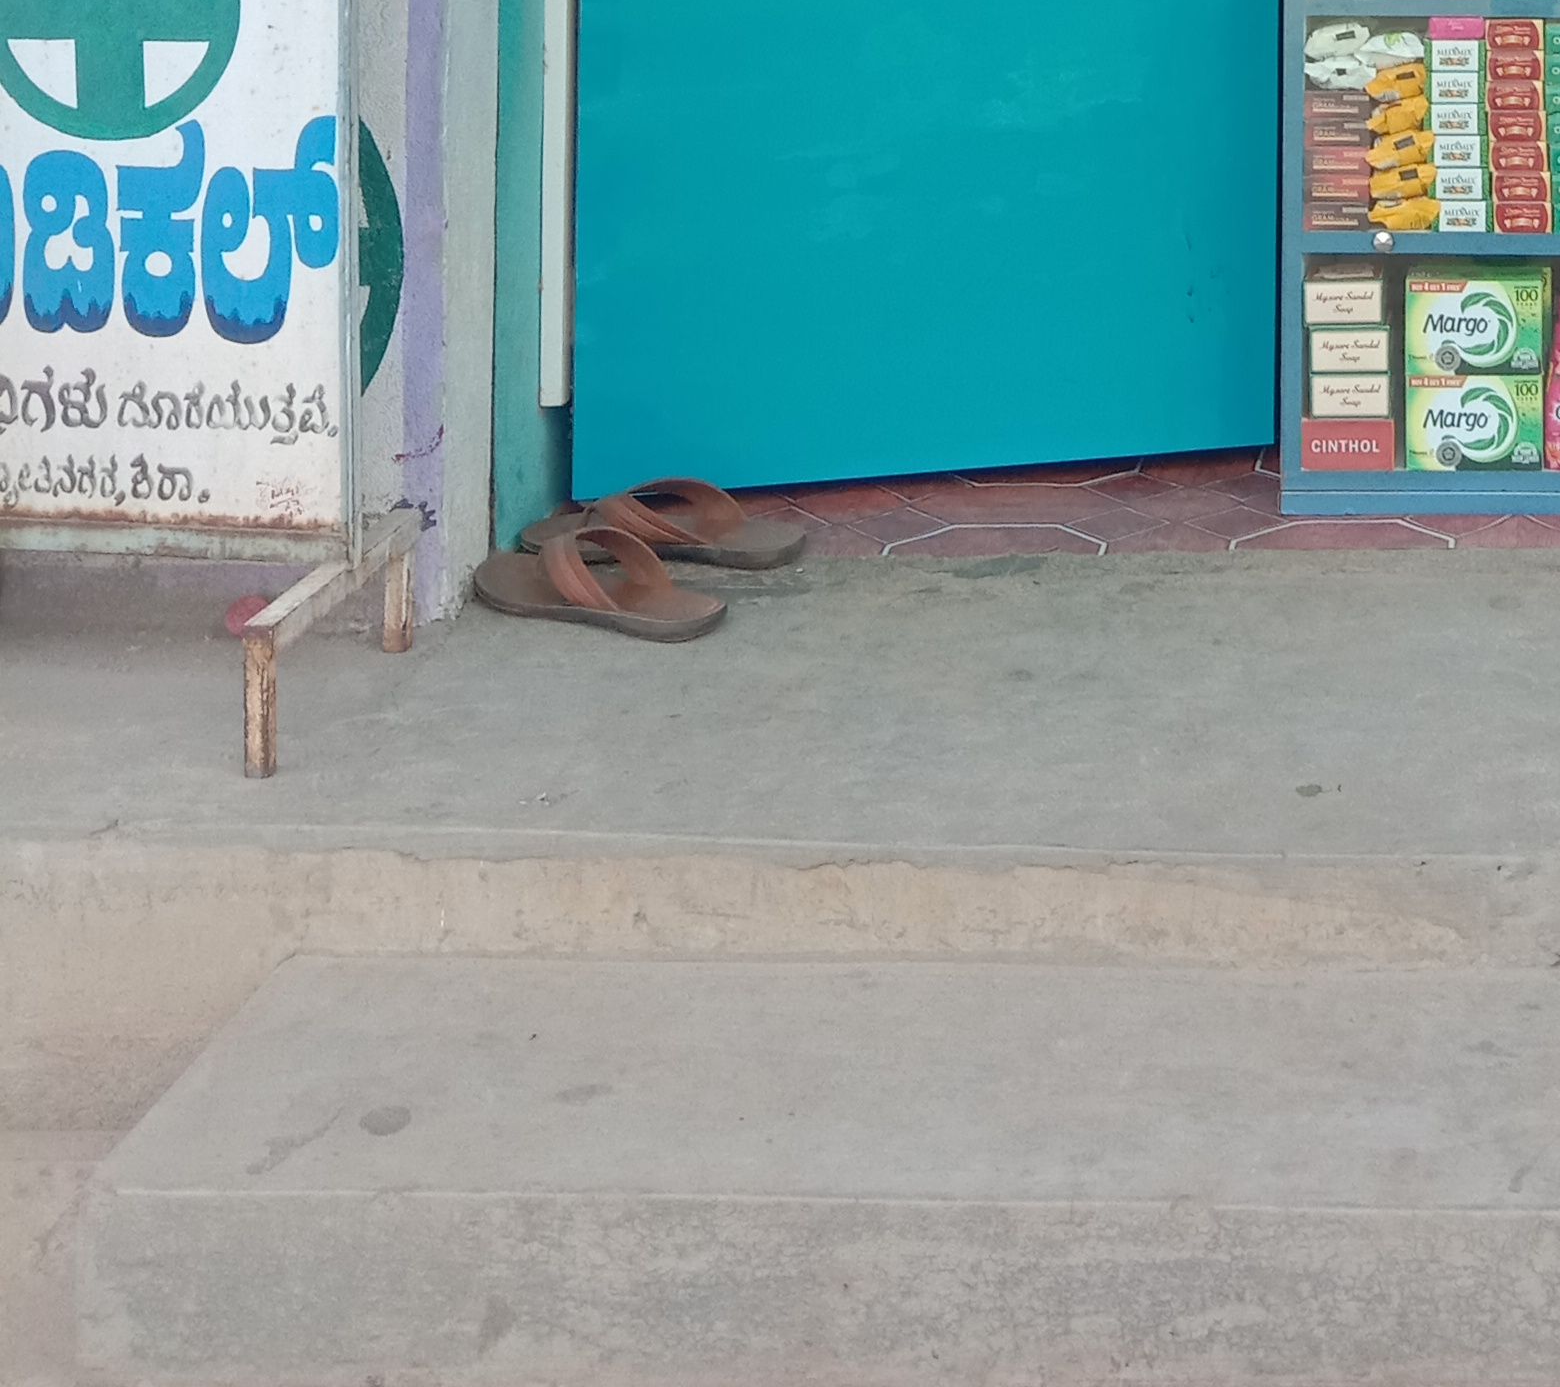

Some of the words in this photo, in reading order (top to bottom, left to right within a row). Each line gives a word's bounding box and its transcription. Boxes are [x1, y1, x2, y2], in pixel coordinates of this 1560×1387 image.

[1514, 288, 1539, 302] 100
[1422, 313, 1489, 337] Margo
[1514, 383, 1538, 396] 100
[1422, 408, 1489, 432] Margo
[1310, 439, 1381, 454] CINTHOL
